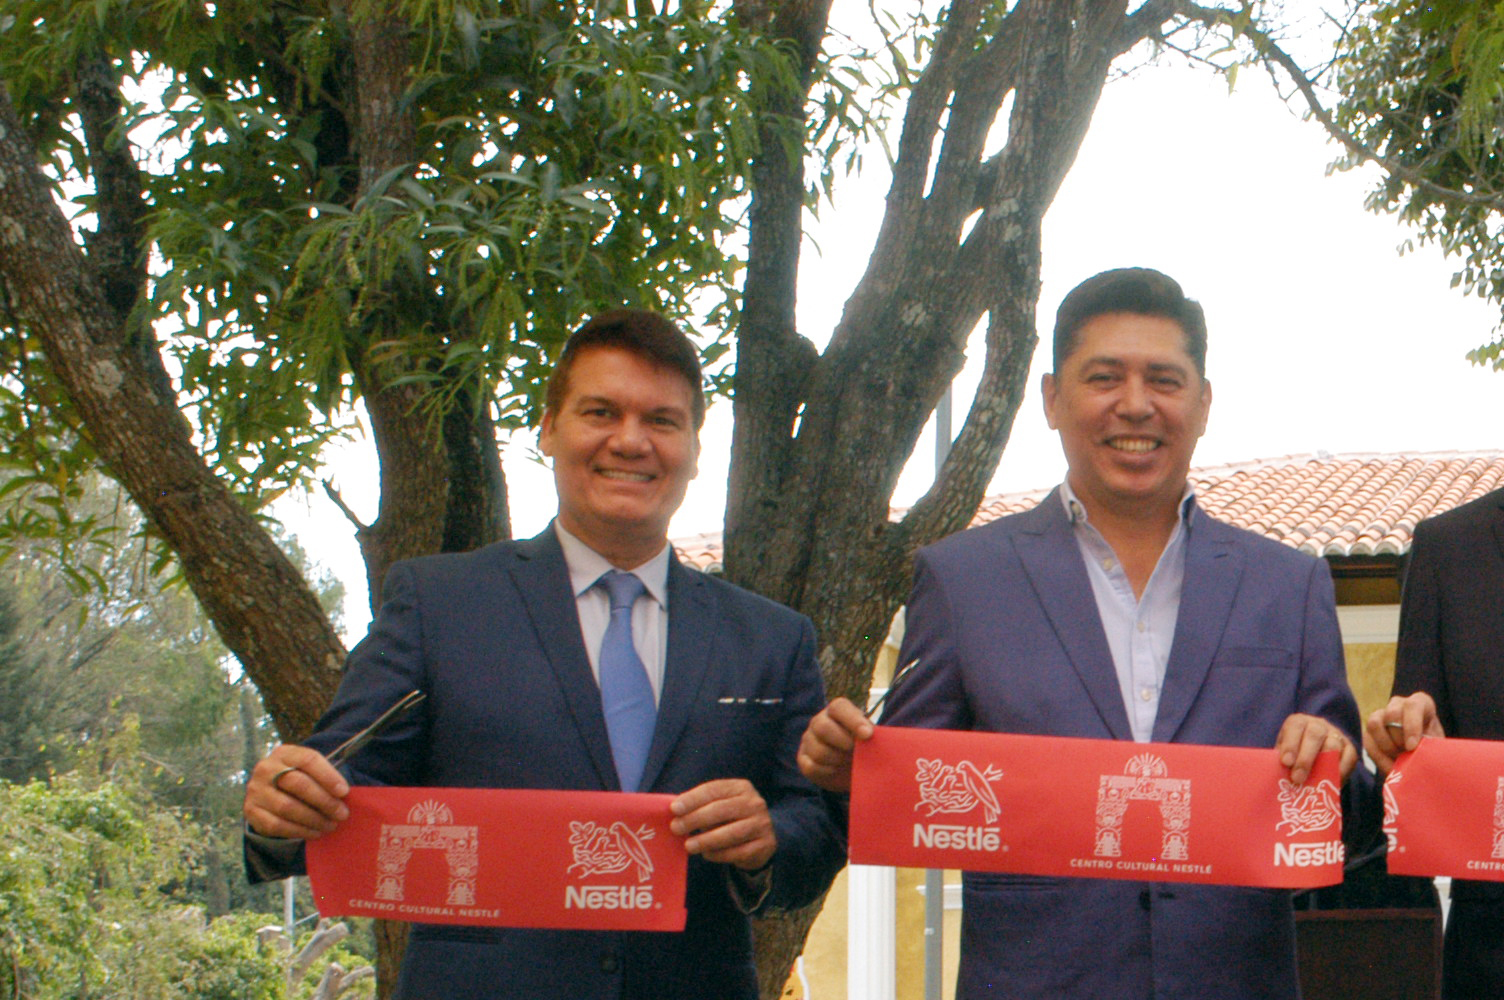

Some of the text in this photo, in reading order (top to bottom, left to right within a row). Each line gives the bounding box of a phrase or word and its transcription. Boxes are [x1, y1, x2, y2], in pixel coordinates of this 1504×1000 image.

[913, 823, 1000, 851] Nestlé
[1070, 858, 1212, 874] CENTRO CULTURAL NESTLÉ
[564, 885, 653, 909] Nestlé
[349, 899, 501, 918] CENTRO CULTURAL NESTLÉ
